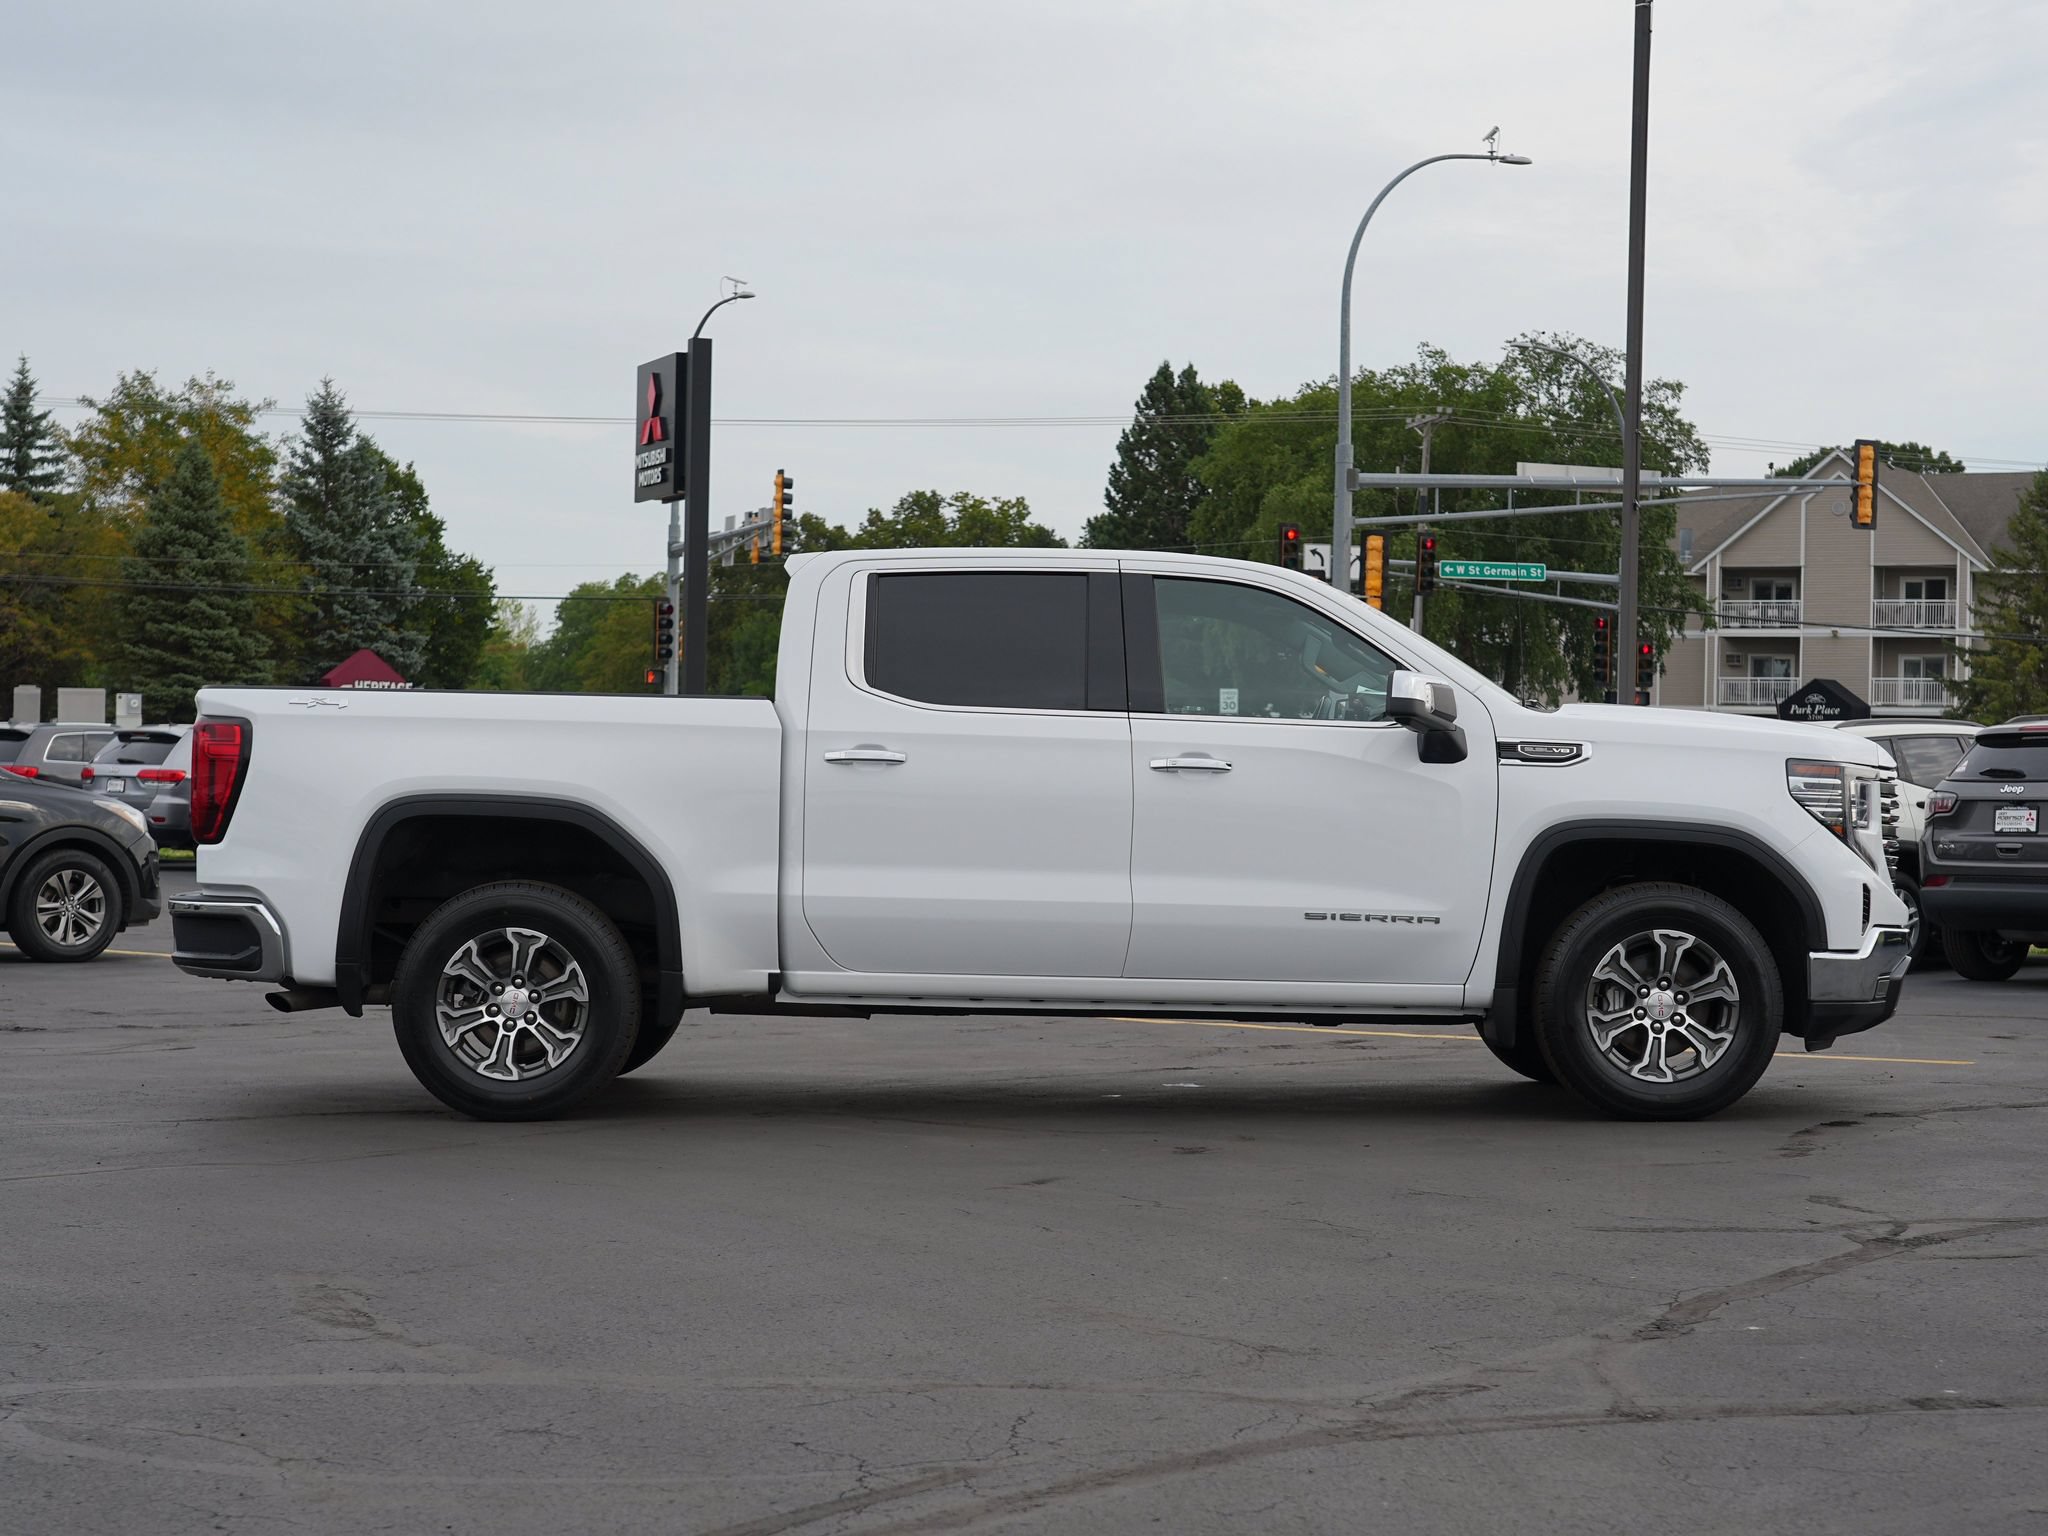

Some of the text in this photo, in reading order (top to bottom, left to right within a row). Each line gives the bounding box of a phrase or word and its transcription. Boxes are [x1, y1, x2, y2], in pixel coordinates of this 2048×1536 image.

[635, 447, 667, 469] MITSUBISHI
[638, 467, 662, 487] MOTORS
[1456, 565, 1542, 577] W St Germain St
[354, 680, 413, 690] HERITAGE
[1222, 701, 1237, 710] 30
[1790, 704, 1840, 715] Park Place
[2000, 784, 2024, 794] Jeep
[1304, 912, 1441, 925] SIERRA
[509, 992, 519, 1014] GMC
